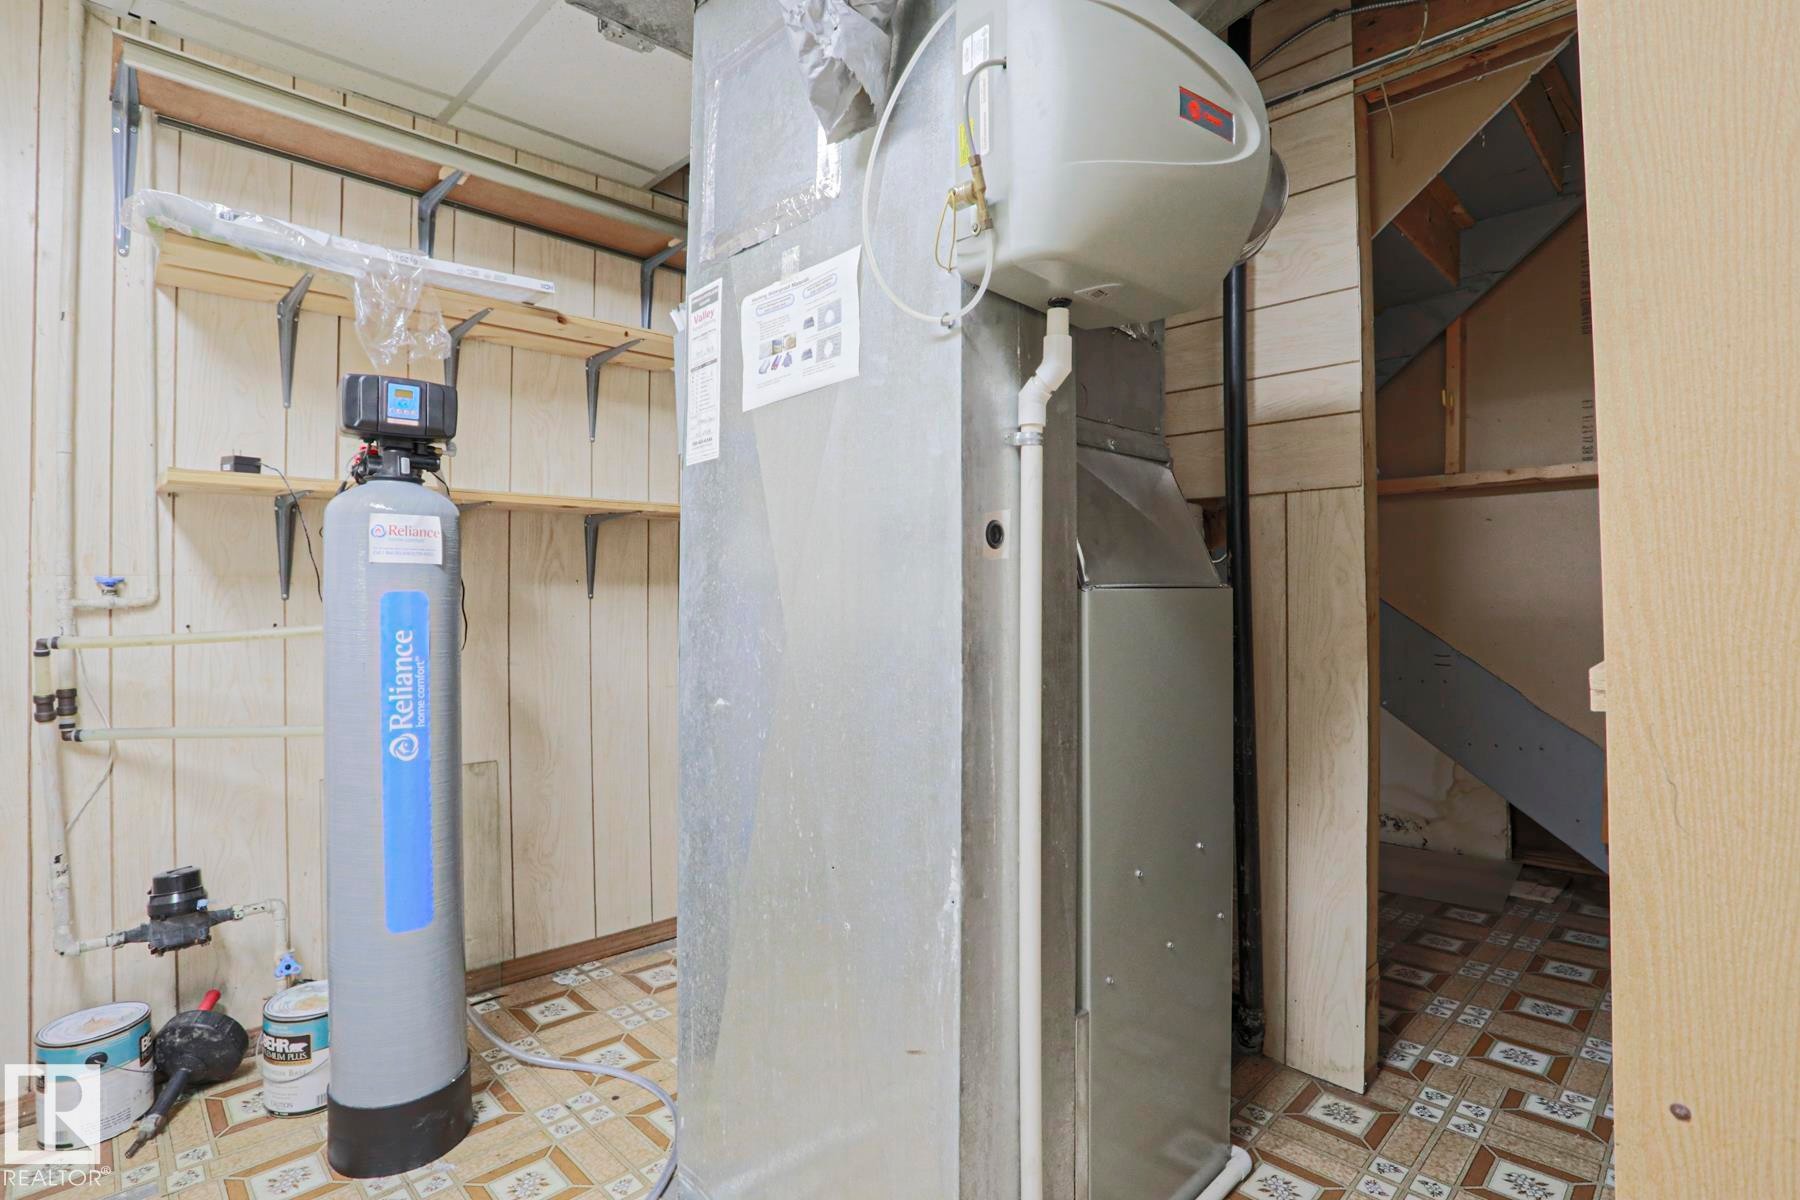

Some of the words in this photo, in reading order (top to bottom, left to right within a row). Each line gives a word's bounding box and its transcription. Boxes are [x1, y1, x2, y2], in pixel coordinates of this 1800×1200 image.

[694, 309, 714, 325] Valley
[388, 524, 441, 538] Reliance
[388, 629, 413, 732] Reliance
[416, 699, 425, 728] home
[263, 1034, 289, 1053] BEHR
[287, 1052, 308, 1060] PLUS
